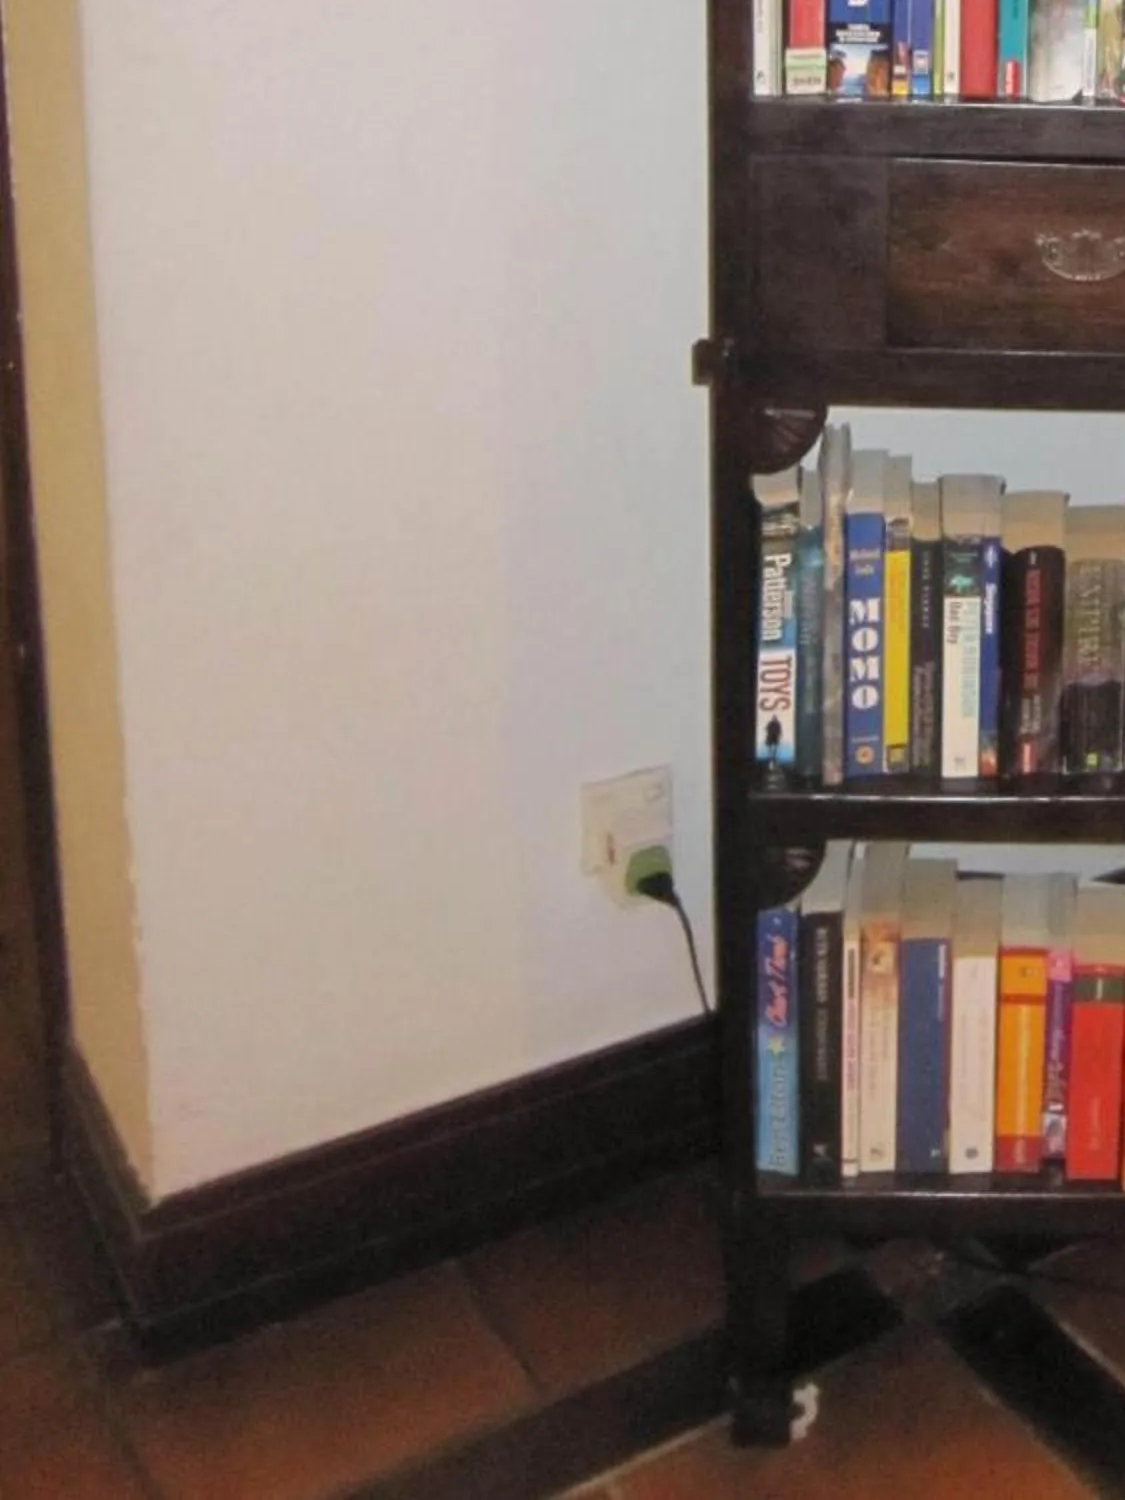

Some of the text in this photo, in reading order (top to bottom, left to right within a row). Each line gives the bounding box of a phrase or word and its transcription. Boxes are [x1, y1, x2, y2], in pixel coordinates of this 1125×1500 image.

[761, 553, 792, 640] Patterson
[984, 582, 997, 634] Singapore
[760, 655, 792, 711] TOYS
[848, 597, 880, 709] MOMO
